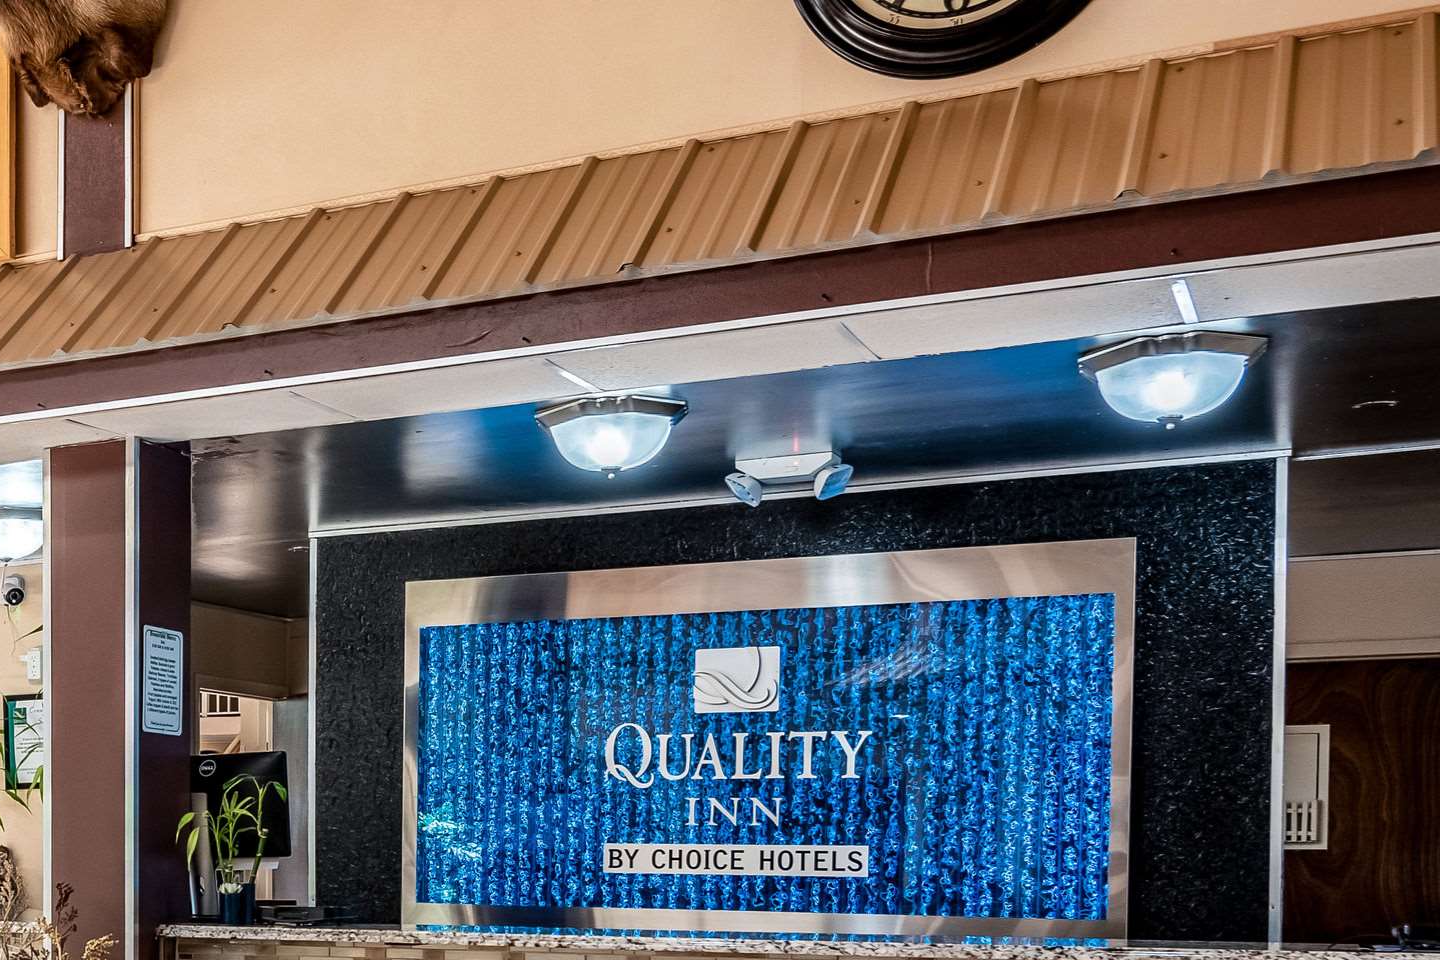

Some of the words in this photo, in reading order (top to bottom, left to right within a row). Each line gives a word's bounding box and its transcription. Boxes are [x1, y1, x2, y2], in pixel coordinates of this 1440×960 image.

[604, 722, 873, 789] QUALITY
[685, 797, 783, 827] INN
[608, 848, 639, 869] BY
[651, 849, 745, 870] CHOICE
[759, 850, 864, 872] HOTELS
